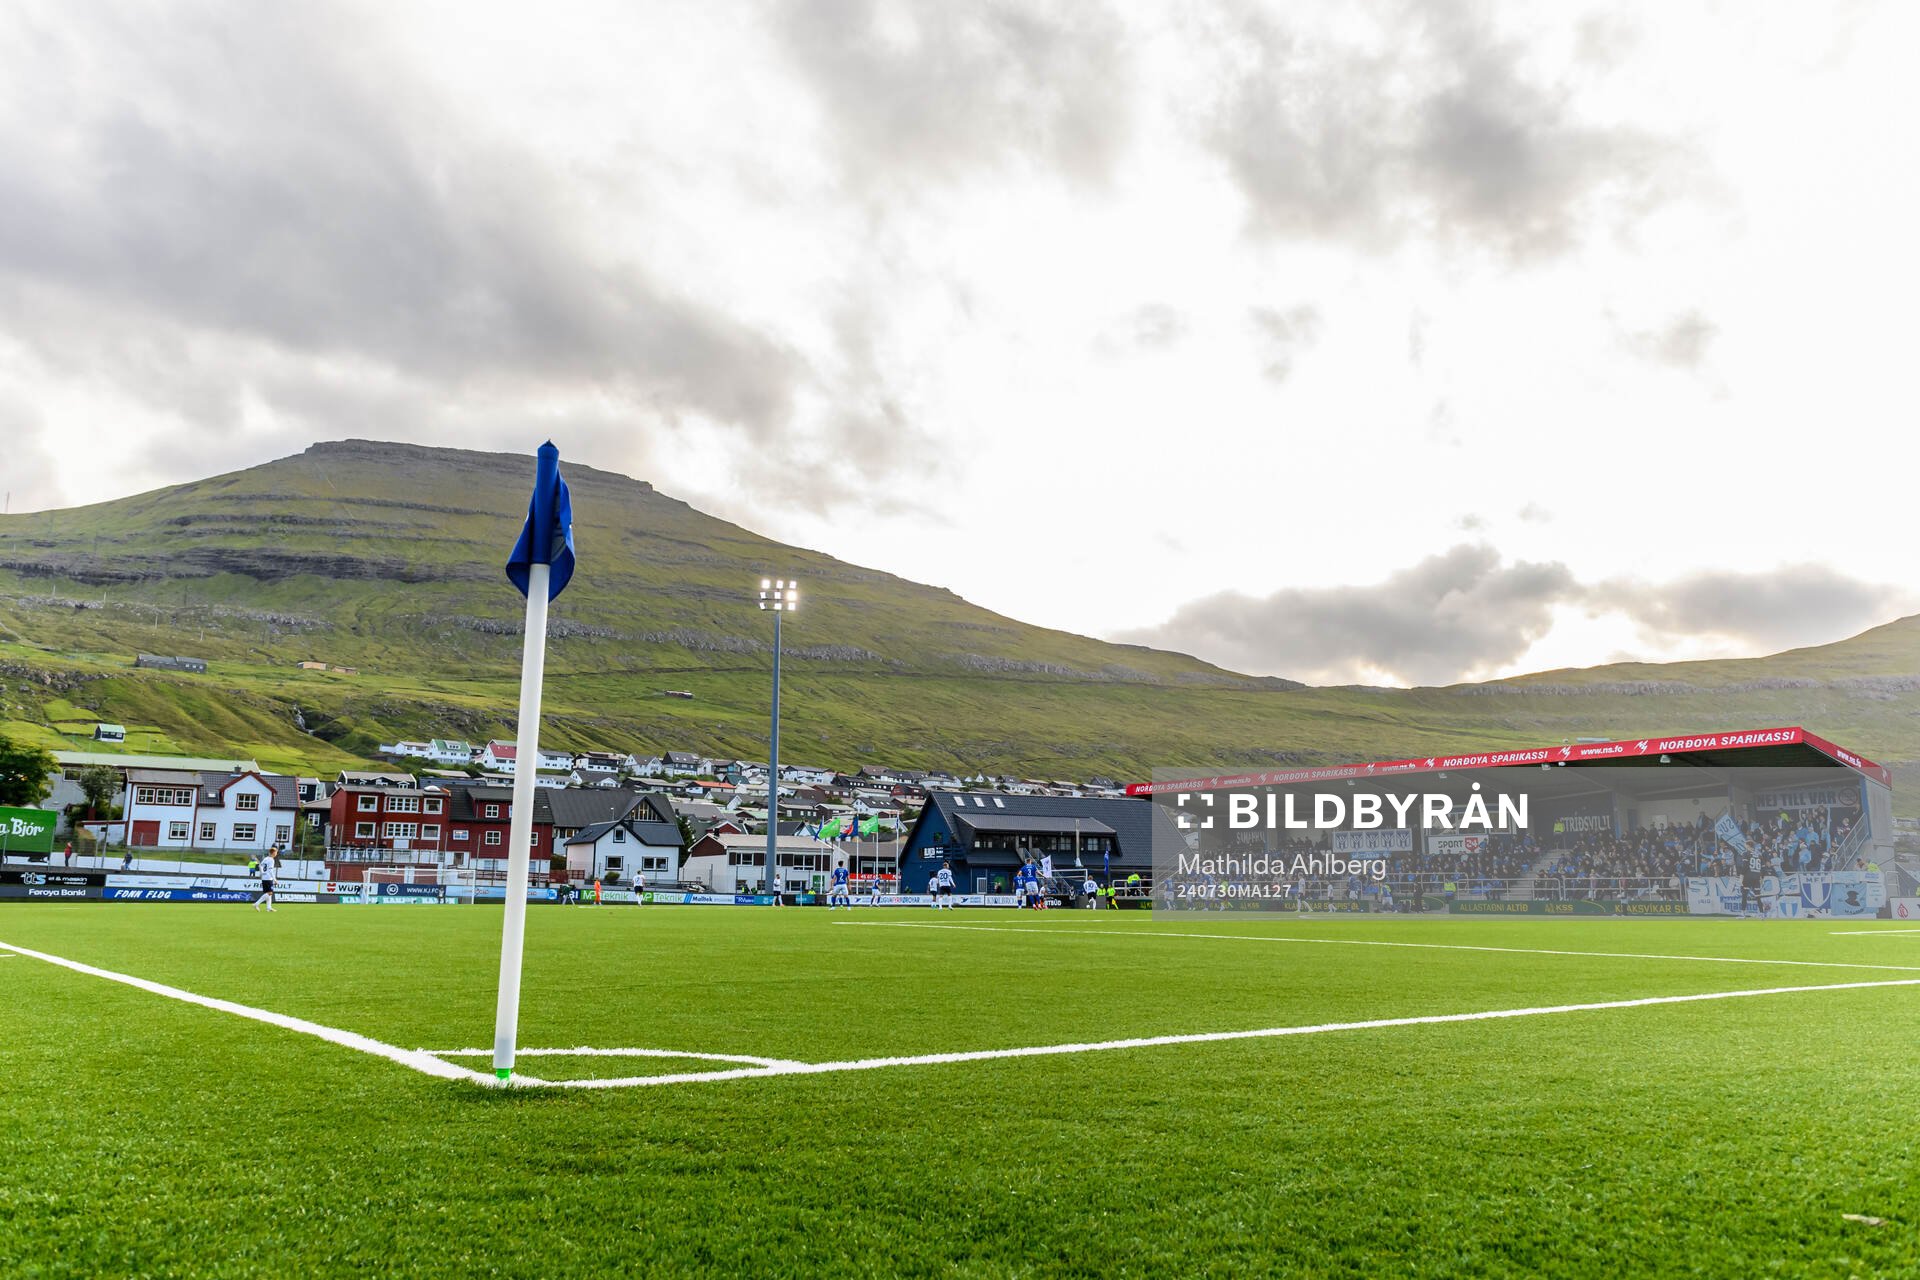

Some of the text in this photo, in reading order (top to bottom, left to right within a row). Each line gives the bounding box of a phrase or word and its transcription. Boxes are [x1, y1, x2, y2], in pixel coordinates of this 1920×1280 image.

[1659, 731, 1796, 751] NORÐOYA SPARIKASSI
[1581, 745, 1624, 756] www.ns.fo
[1491, 751, 1548, 763] SPARIKASSI
[1311, 768, 1357, 779] SPARIKASSI
[1167, 781, 1204, 791] SPARIKASSI
[1782, 791, 1808, 806] TILL
[1809, 789, 1836, 805] VAR
[1438, 838, 1479, 849] SPORT 24
[1749, 857, 1761, 870] 96
[940, 872, 948, 880] 20
[1615, 902, 1671, 913] KAKSVÍKAR
